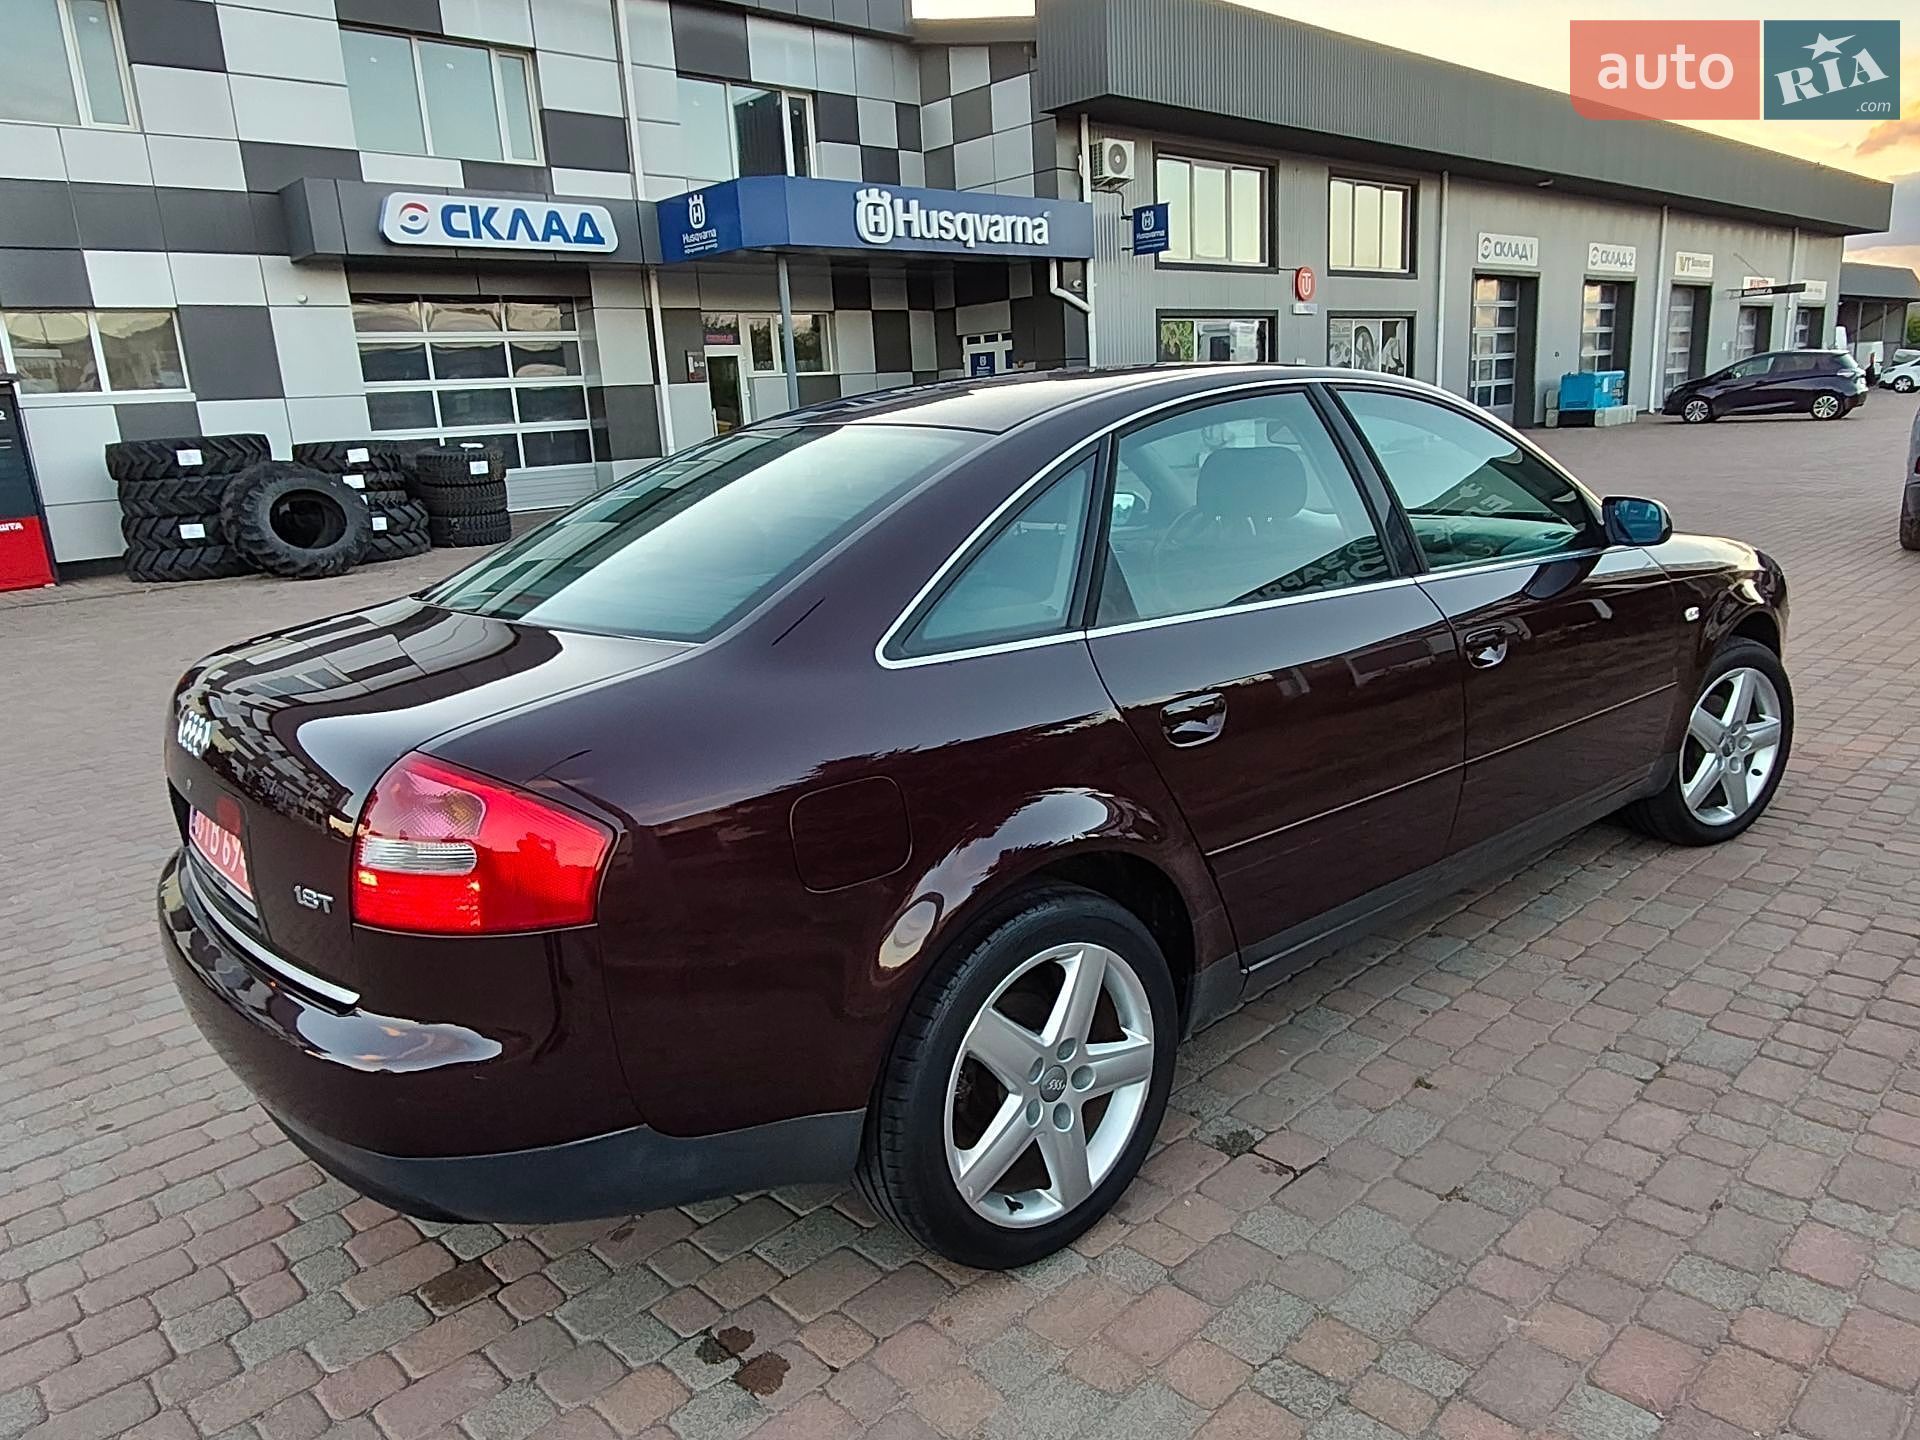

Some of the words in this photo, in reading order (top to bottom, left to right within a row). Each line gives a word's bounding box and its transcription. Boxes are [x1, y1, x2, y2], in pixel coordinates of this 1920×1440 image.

[440, 203, 606, 246] СКЛАД
[893, 198, 1051, 248] Husqvarna
[1494, 240, 1529, 261] СКЛАД
[1600, 249, 1628, 268] СКЛАД
